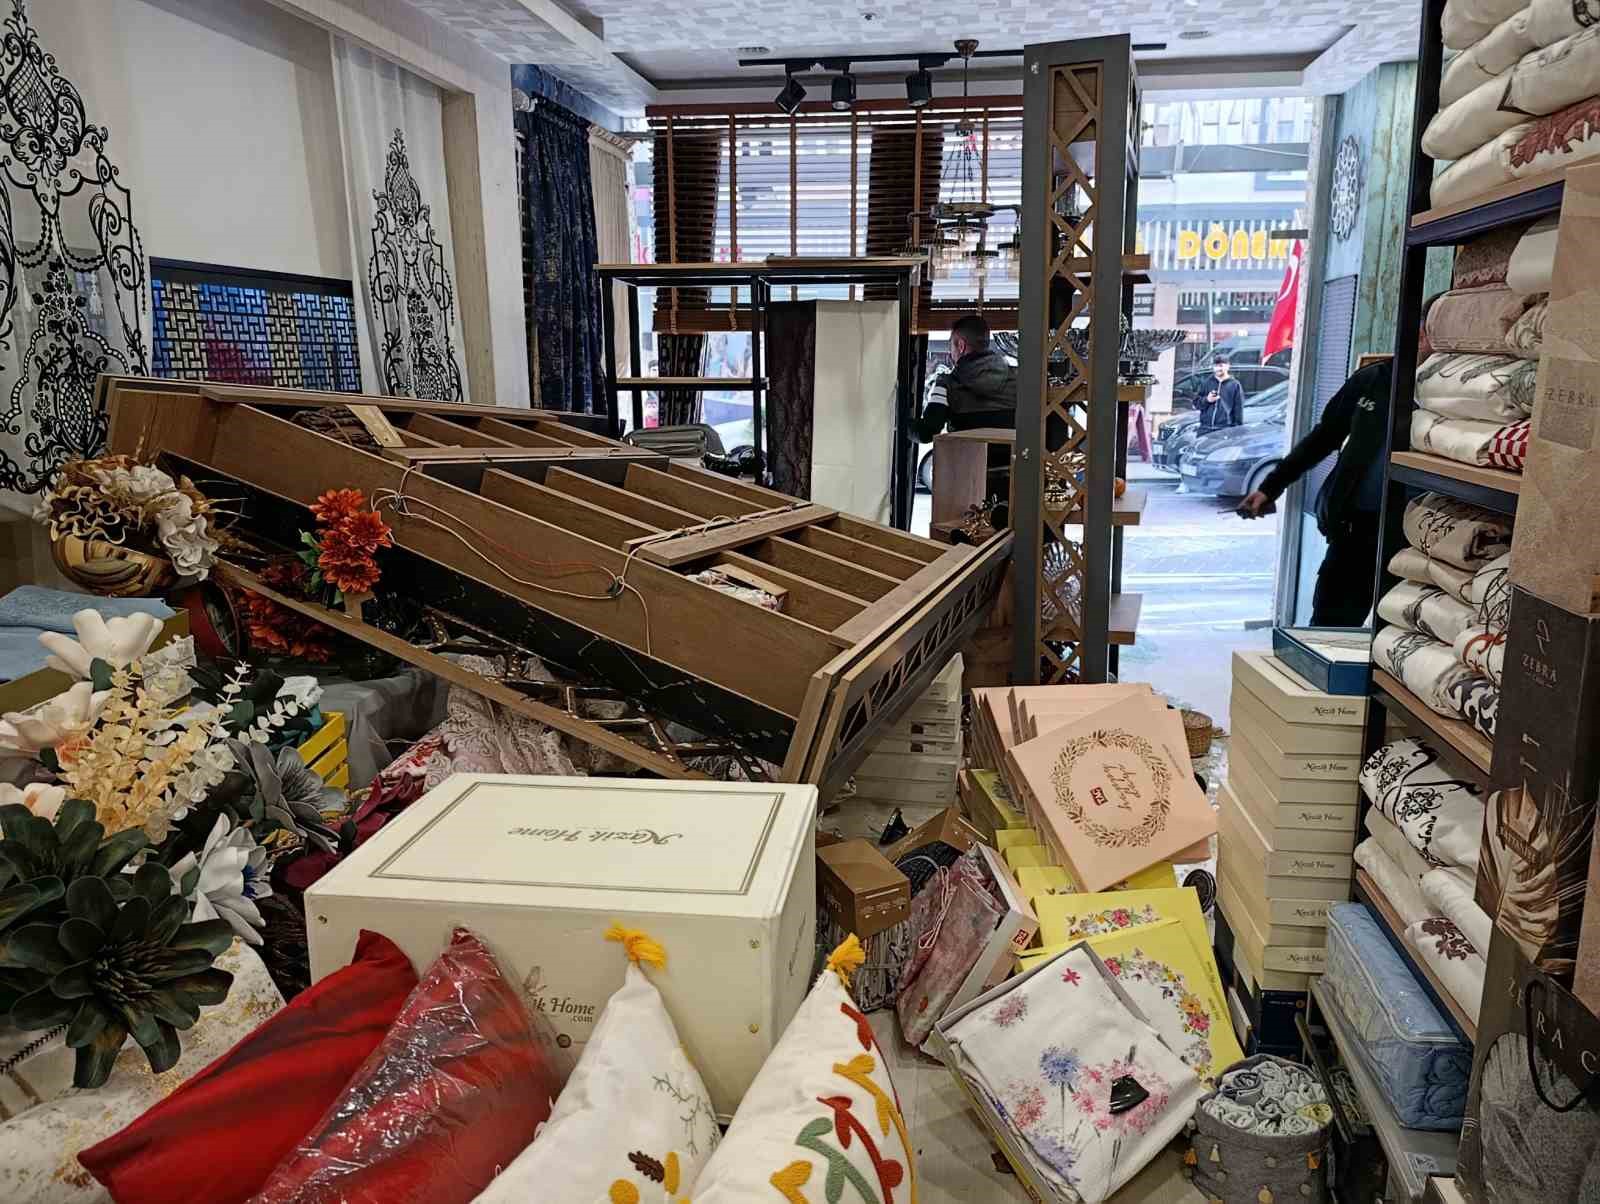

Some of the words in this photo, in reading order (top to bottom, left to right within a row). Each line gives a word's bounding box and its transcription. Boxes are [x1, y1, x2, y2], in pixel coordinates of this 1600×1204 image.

[1521, 653, 1558, 683] ZEBRA
[507, 827, 582, 842] Home
[588, 828, 684, 845] Nazik
[550, 996, 596, 1015] Home
